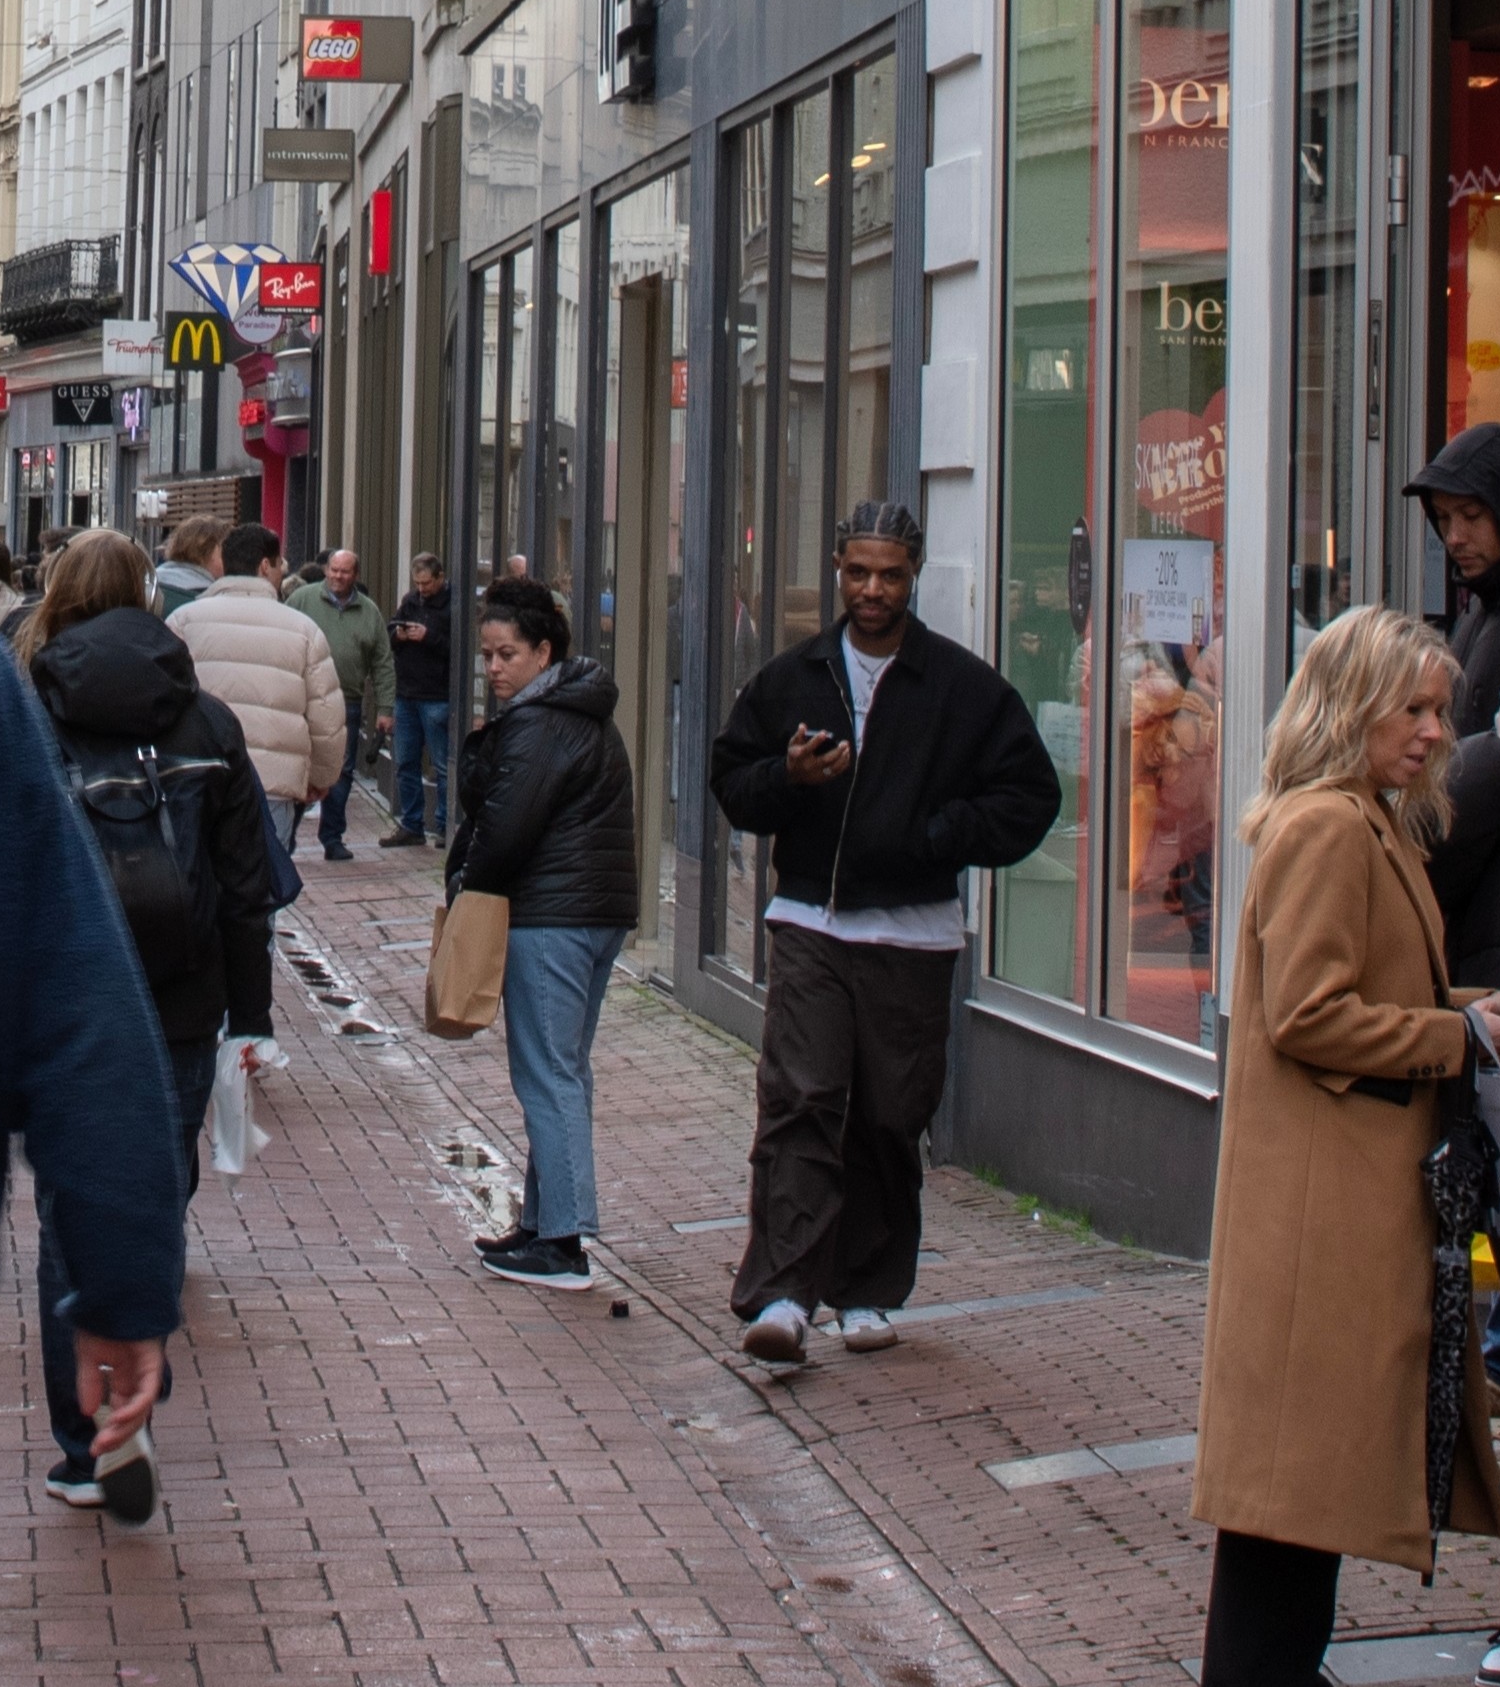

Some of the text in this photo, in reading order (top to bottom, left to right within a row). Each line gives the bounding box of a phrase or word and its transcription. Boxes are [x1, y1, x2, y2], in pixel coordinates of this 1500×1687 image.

[307, 37, 359, 61] LEGO
[267, 149, 349, 161] intimissimi
[238, 320, 277, 329] Paradise
[57, 385, 110, 398] GUESS
[1155, 551, 1178, 587] -20%
